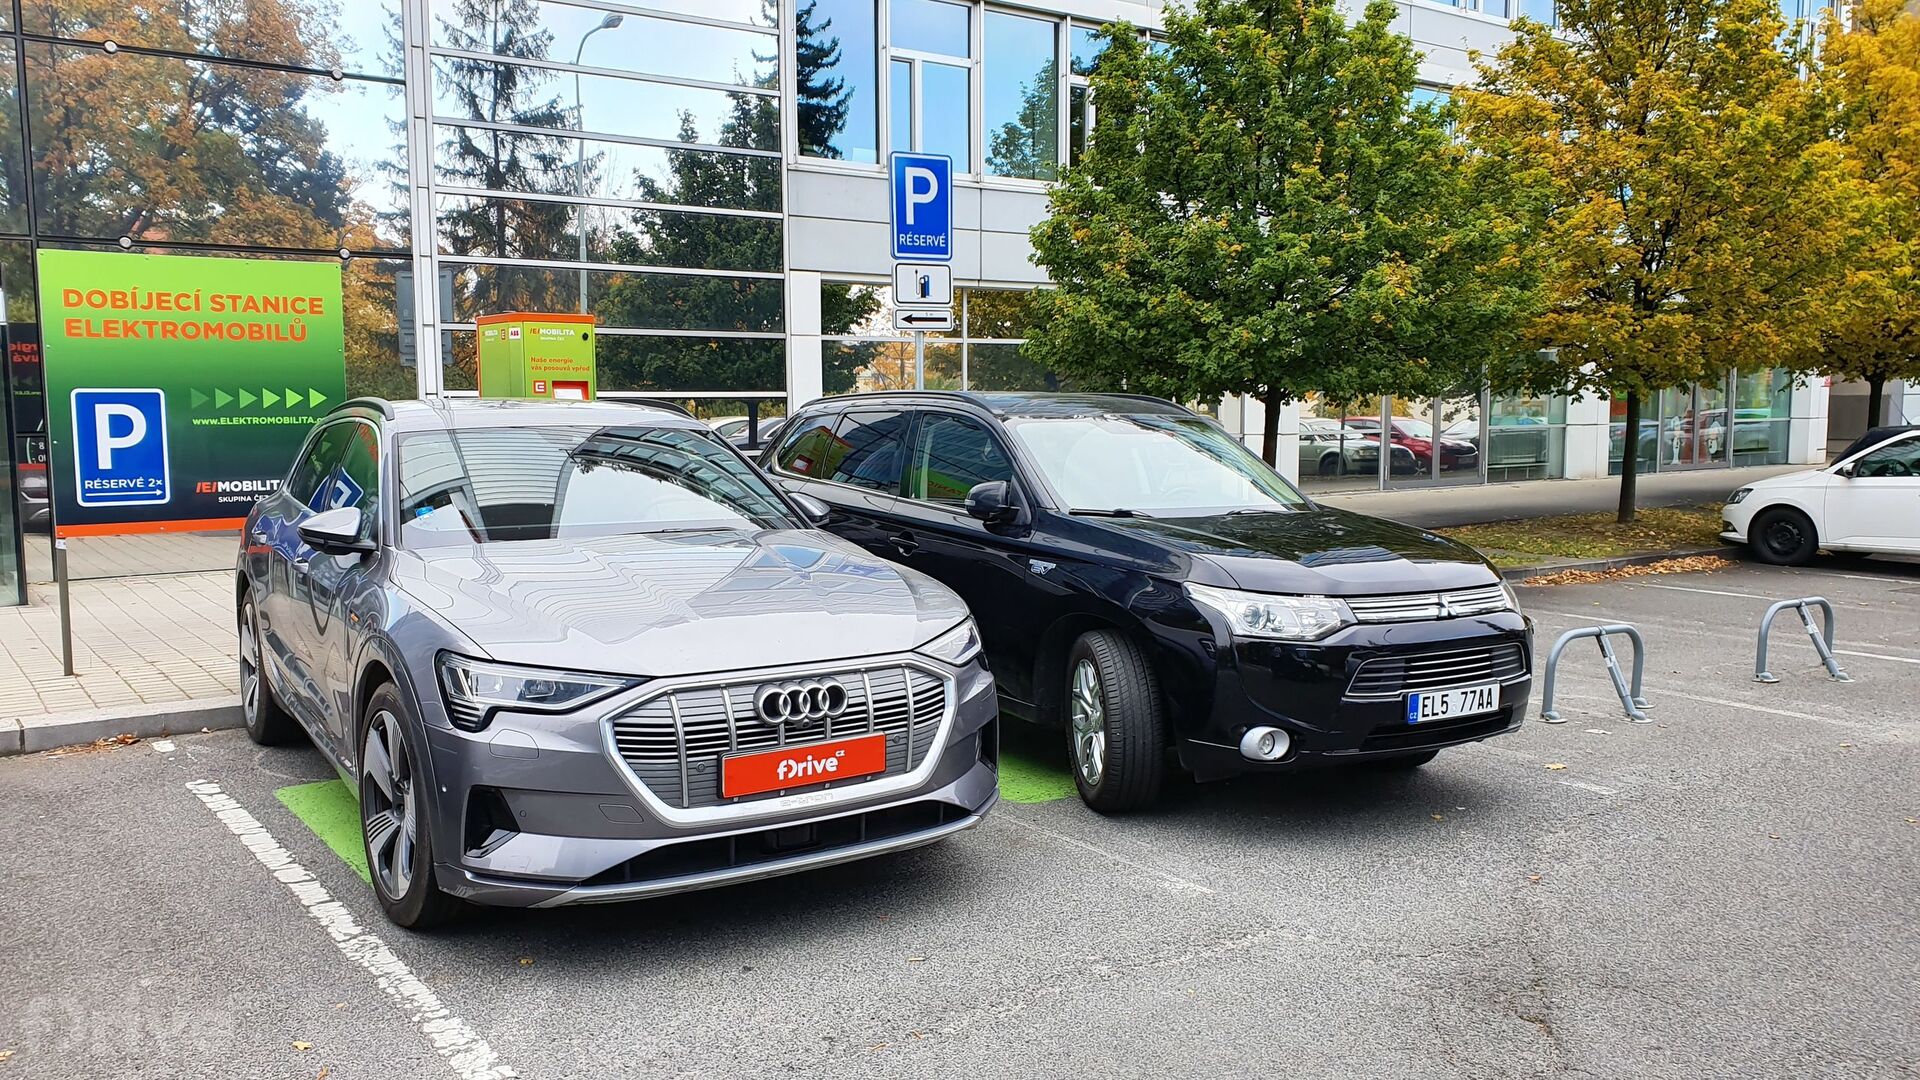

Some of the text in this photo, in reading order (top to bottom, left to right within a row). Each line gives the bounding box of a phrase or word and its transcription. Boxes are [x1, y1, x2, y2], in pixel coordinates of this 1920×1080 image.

[905, 167, 938, 225] P
[899, 232, 946, 247] RÉSERVÉ
[62, 286, 324, 315] DOBÍJECÍ STANICE
[64, 317, 307, 342] ELEKTROMOBILŮ
[95, 403, 147, 469] P
[84, 476, 144, 489] RÉSERVÉ
[218, 495, 252, 503] SKUPINA
[1422, 687, 1492, 718] EL5 77AA
